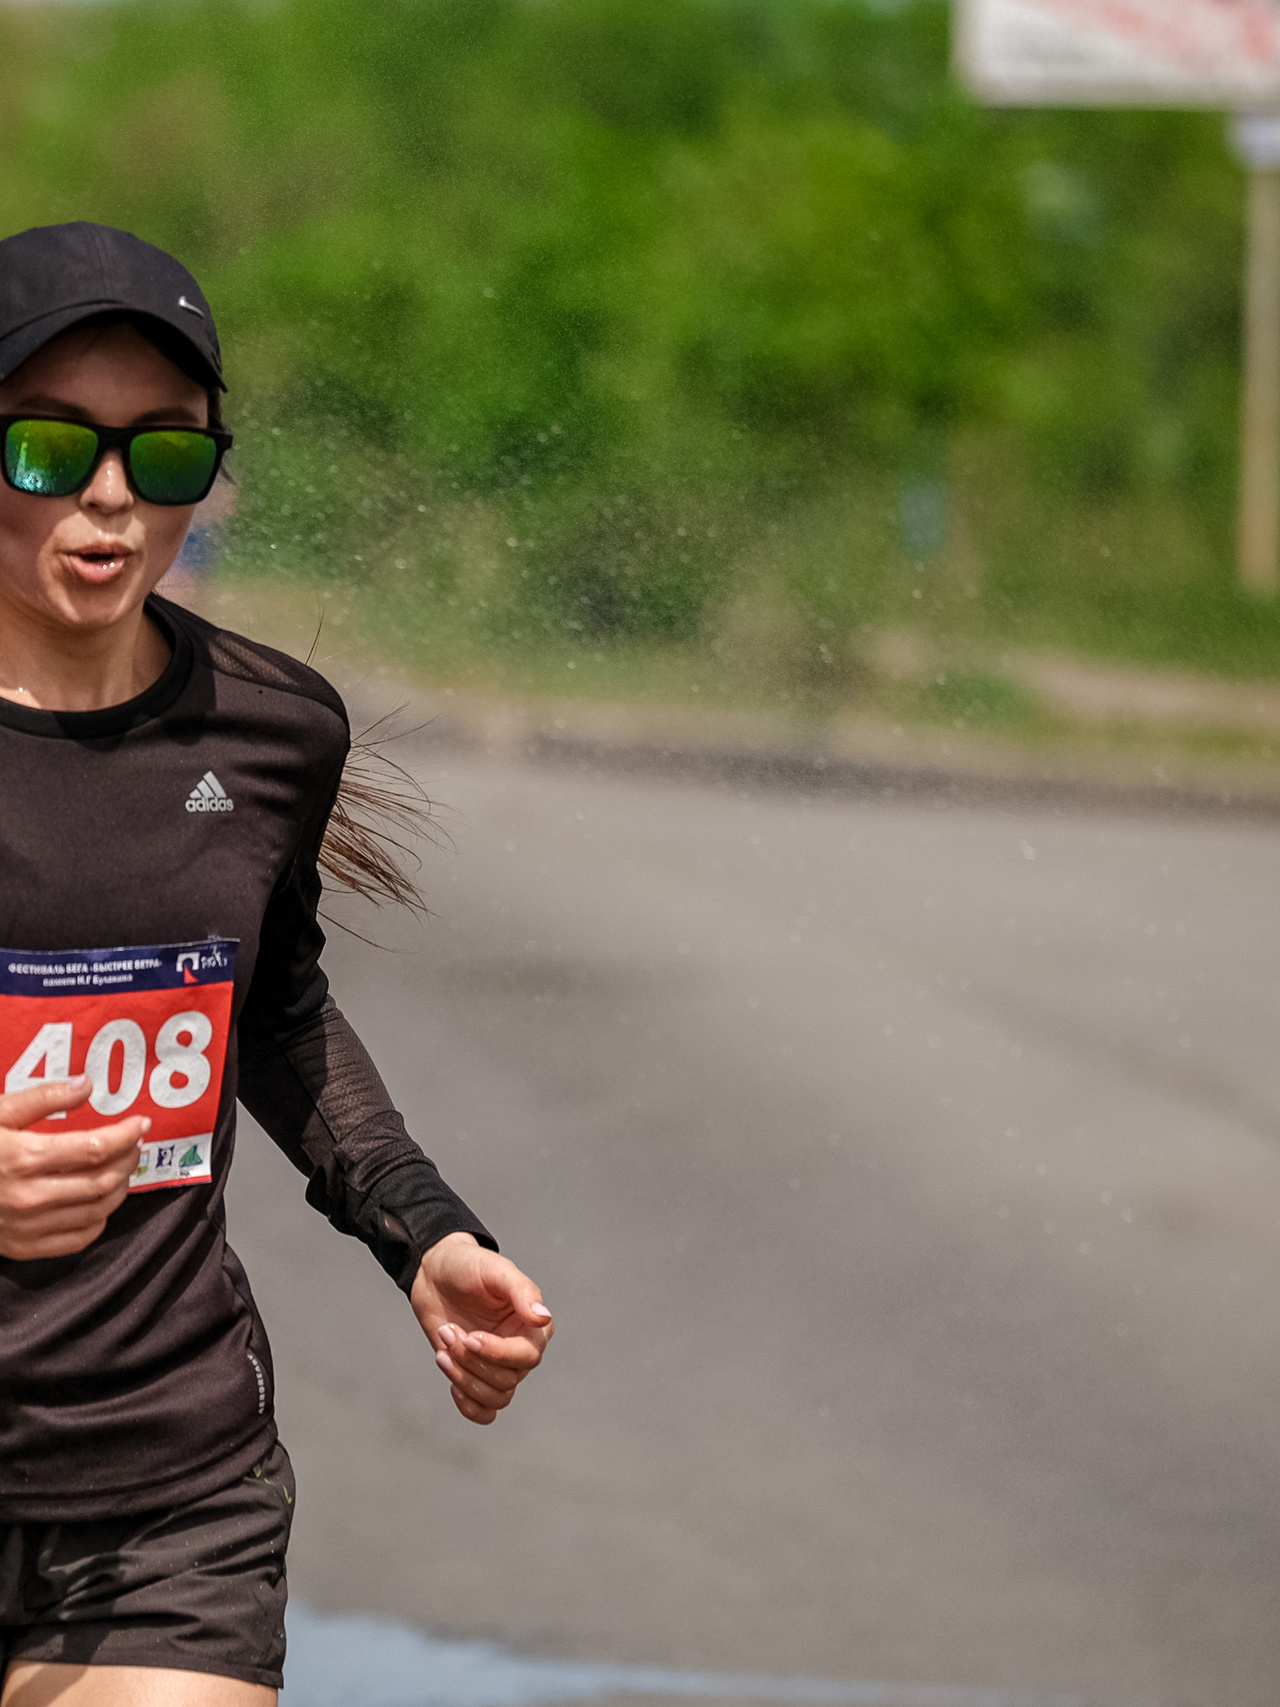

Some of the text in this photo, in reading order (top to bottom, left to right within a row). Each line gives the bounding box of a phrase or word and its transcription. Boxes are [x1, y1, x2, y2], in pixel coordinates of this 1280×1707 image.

[185, 796, 234, 813] adidas
[8, 963, 65, 975] ФЕСТИВАЛЬ
[66, 963, 89, 974] БЕГА
[247, 1354, 266, 1415] AEROREADY
